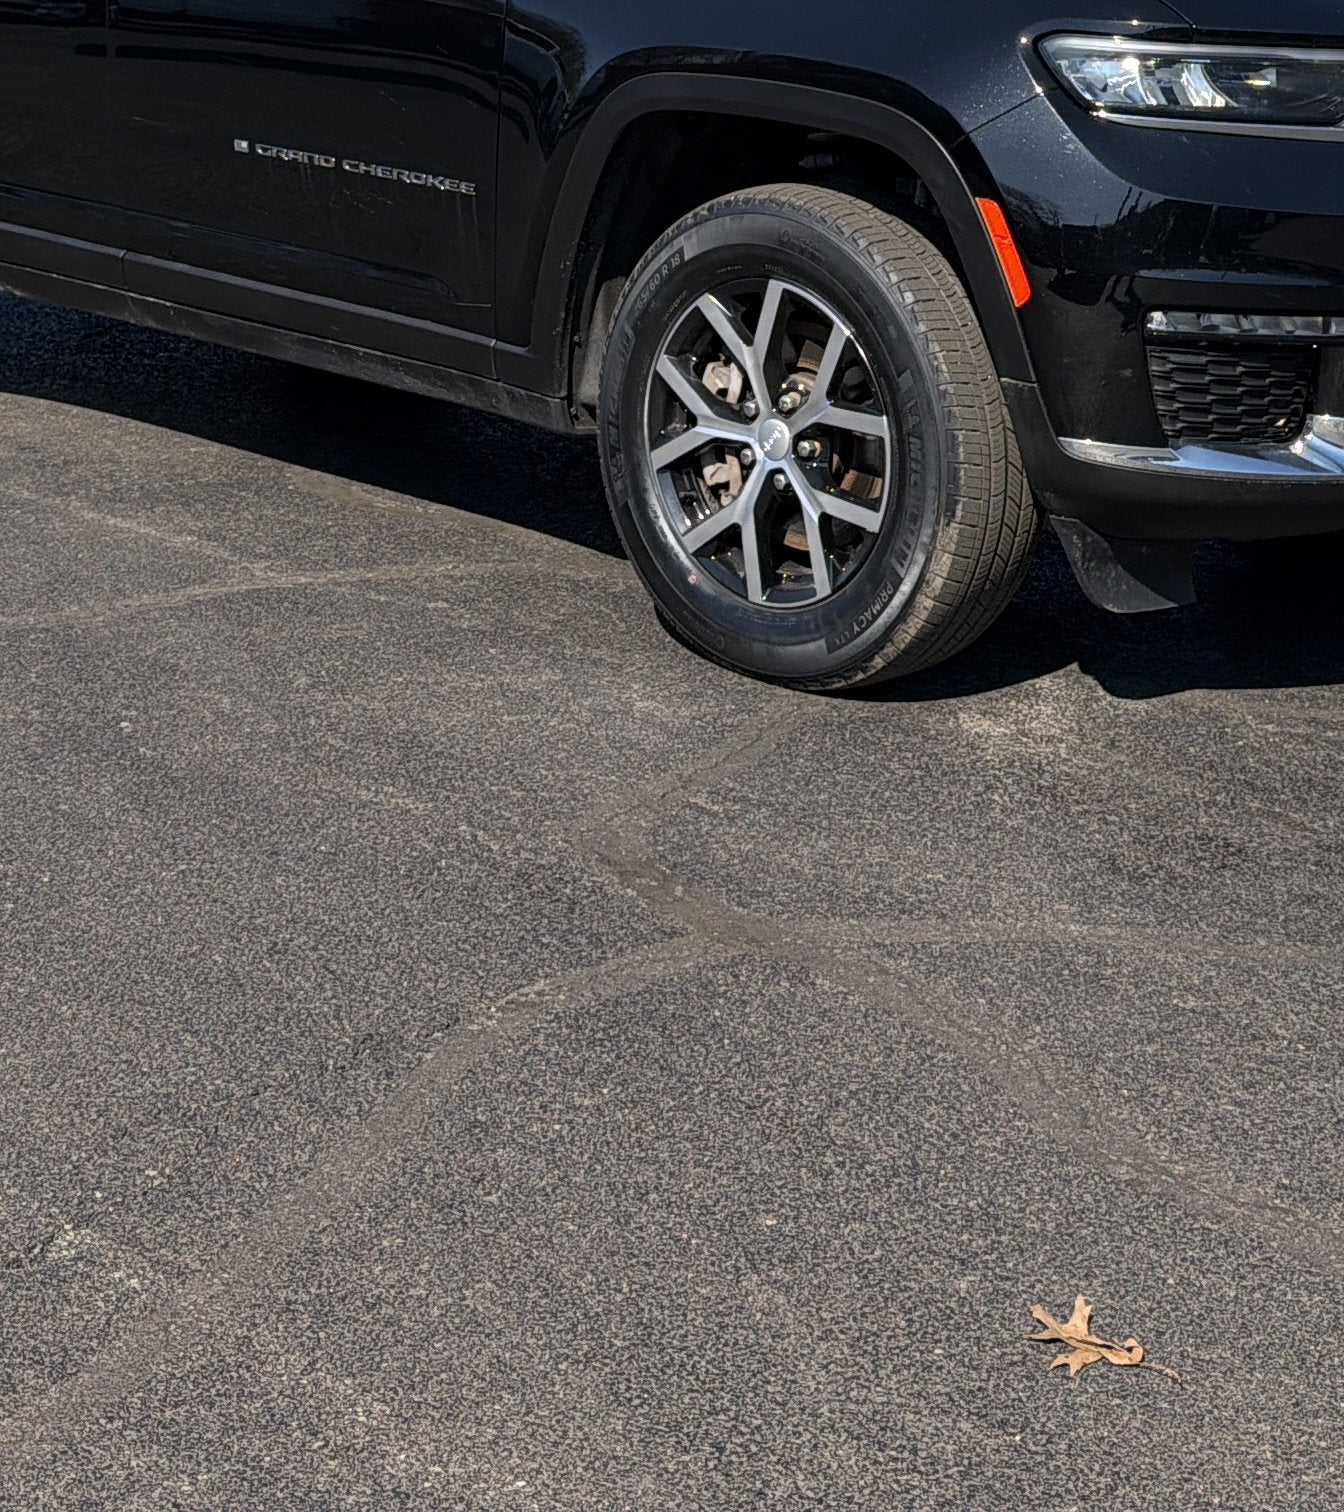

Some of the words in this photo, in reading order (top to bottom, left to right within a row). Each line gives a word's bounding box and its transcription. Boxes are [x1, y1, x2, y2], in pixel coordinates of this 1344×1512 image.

[255, 143, 337, 169] GRAND
[342, 159, 477, 196] CHEROKEE
[852, 580, 895, 636] PRIMACY
